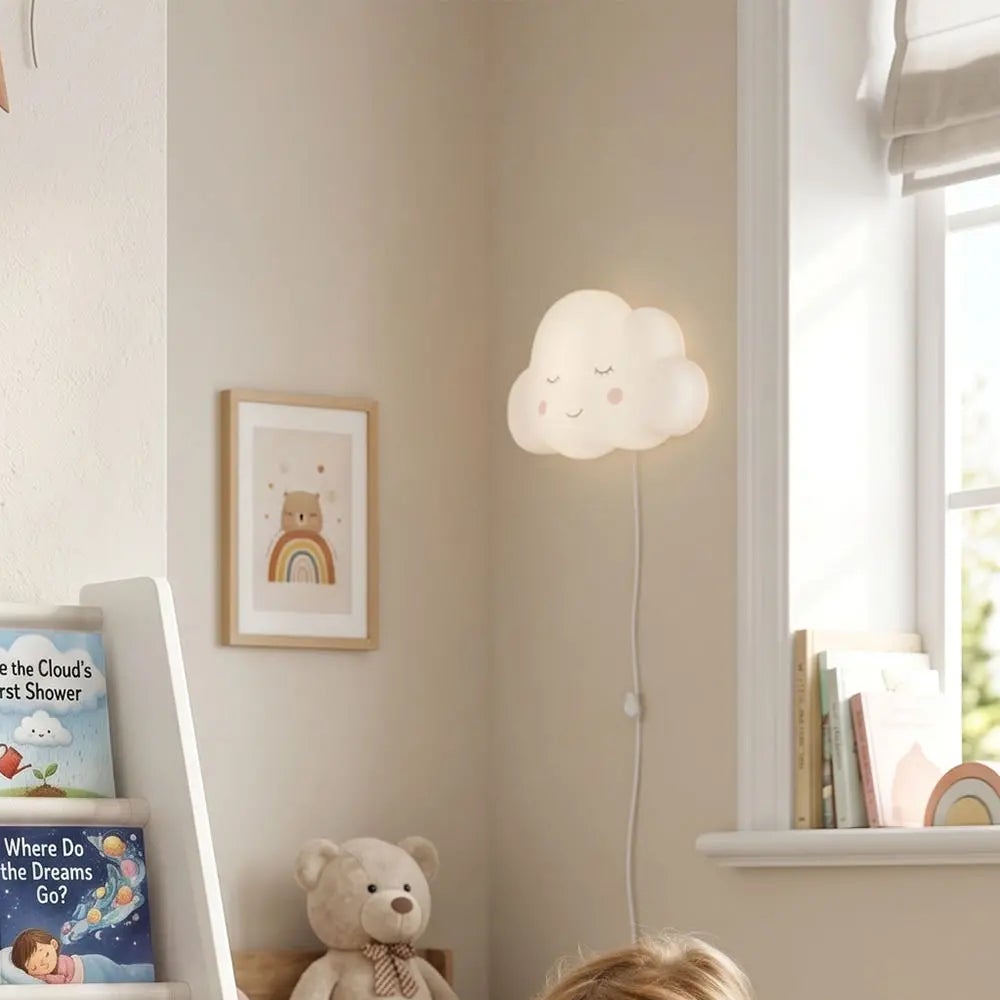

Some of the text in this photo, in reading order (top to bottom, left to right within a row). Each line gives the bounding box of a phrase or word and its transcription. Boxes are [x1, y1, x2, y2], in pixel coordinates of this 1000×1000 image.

[11, 661, 34, 677] the
[38, 659, 92, 679] Cloud's
[25, 682, 82, 701] Shower
[4, 838, 84, 857] Where Do
[1, 862, 93, 881] the Dreams
[36, 885, 67, 904] Go?
